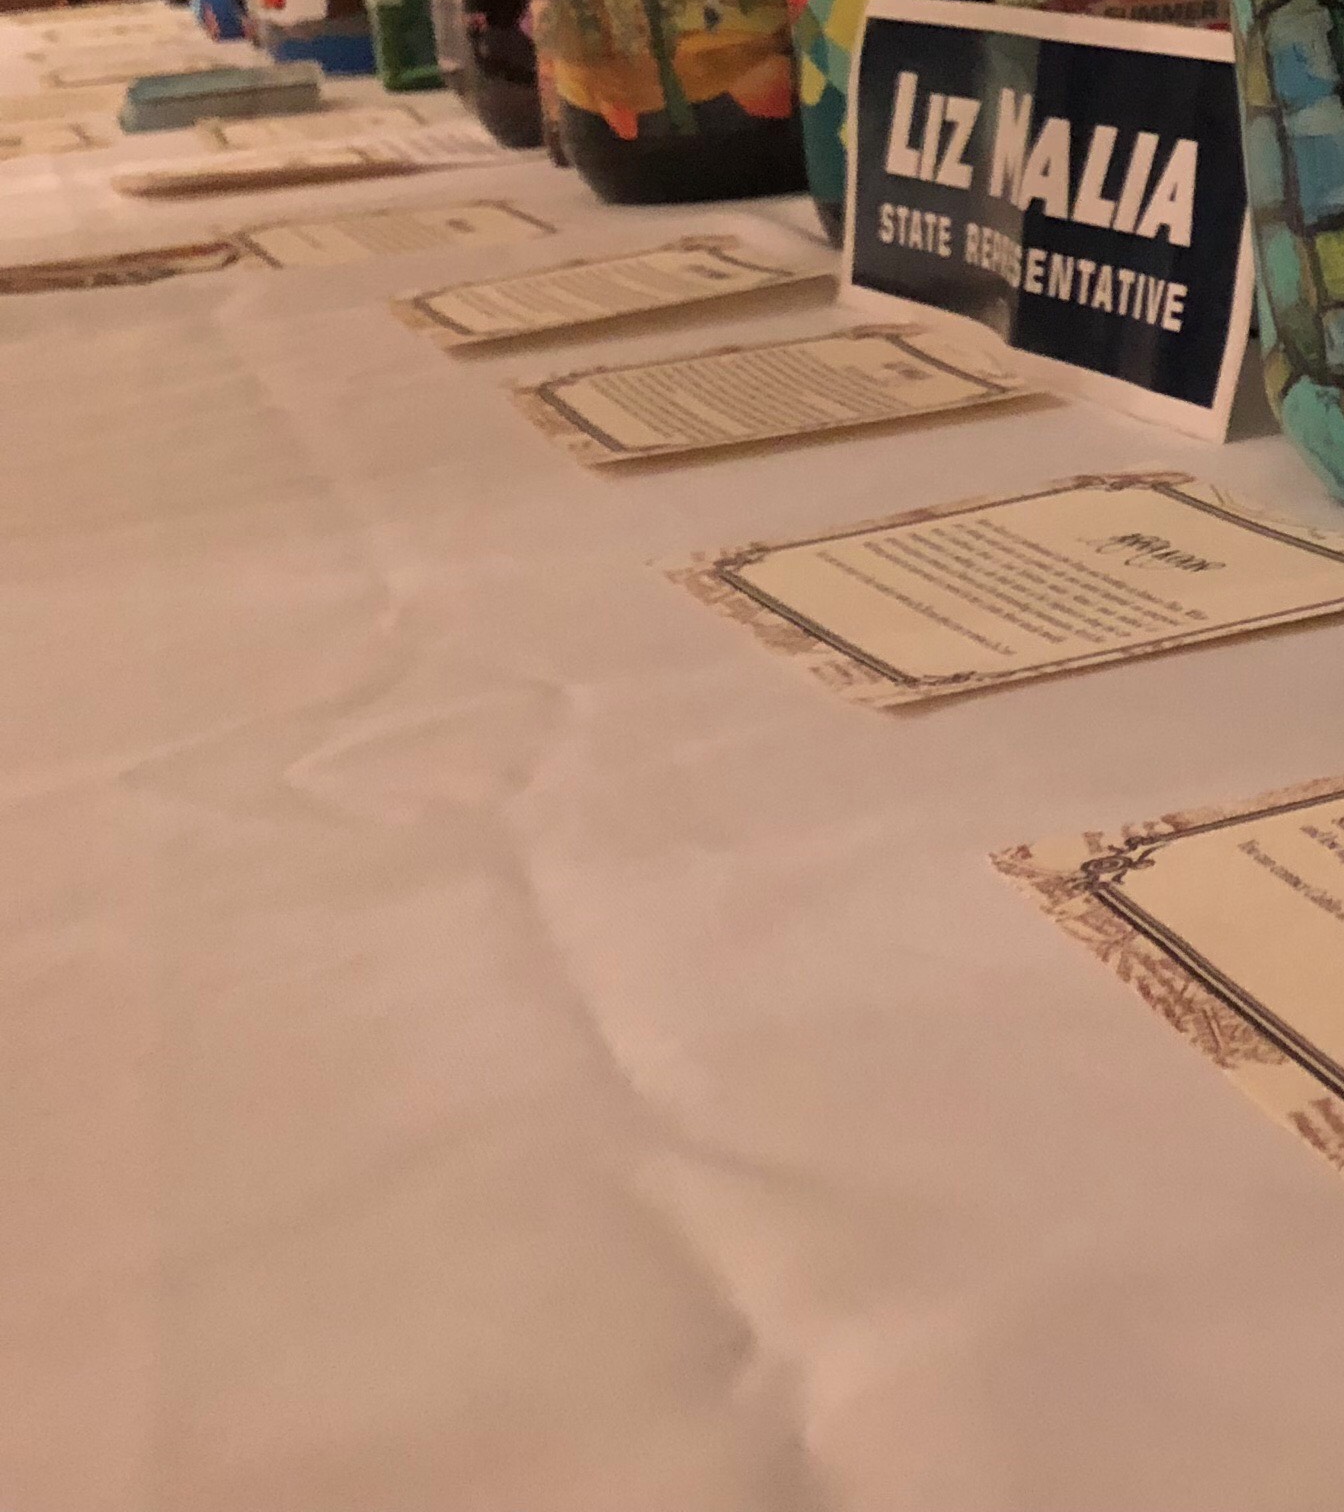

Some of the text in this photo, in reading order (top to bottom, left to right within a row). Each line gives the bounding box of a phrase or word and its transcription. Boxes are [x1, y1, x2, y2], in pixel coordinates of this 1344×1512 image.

[885, 71, 1199, 248] LIZ MALIA
[879, 203, 952, 259] STATE
